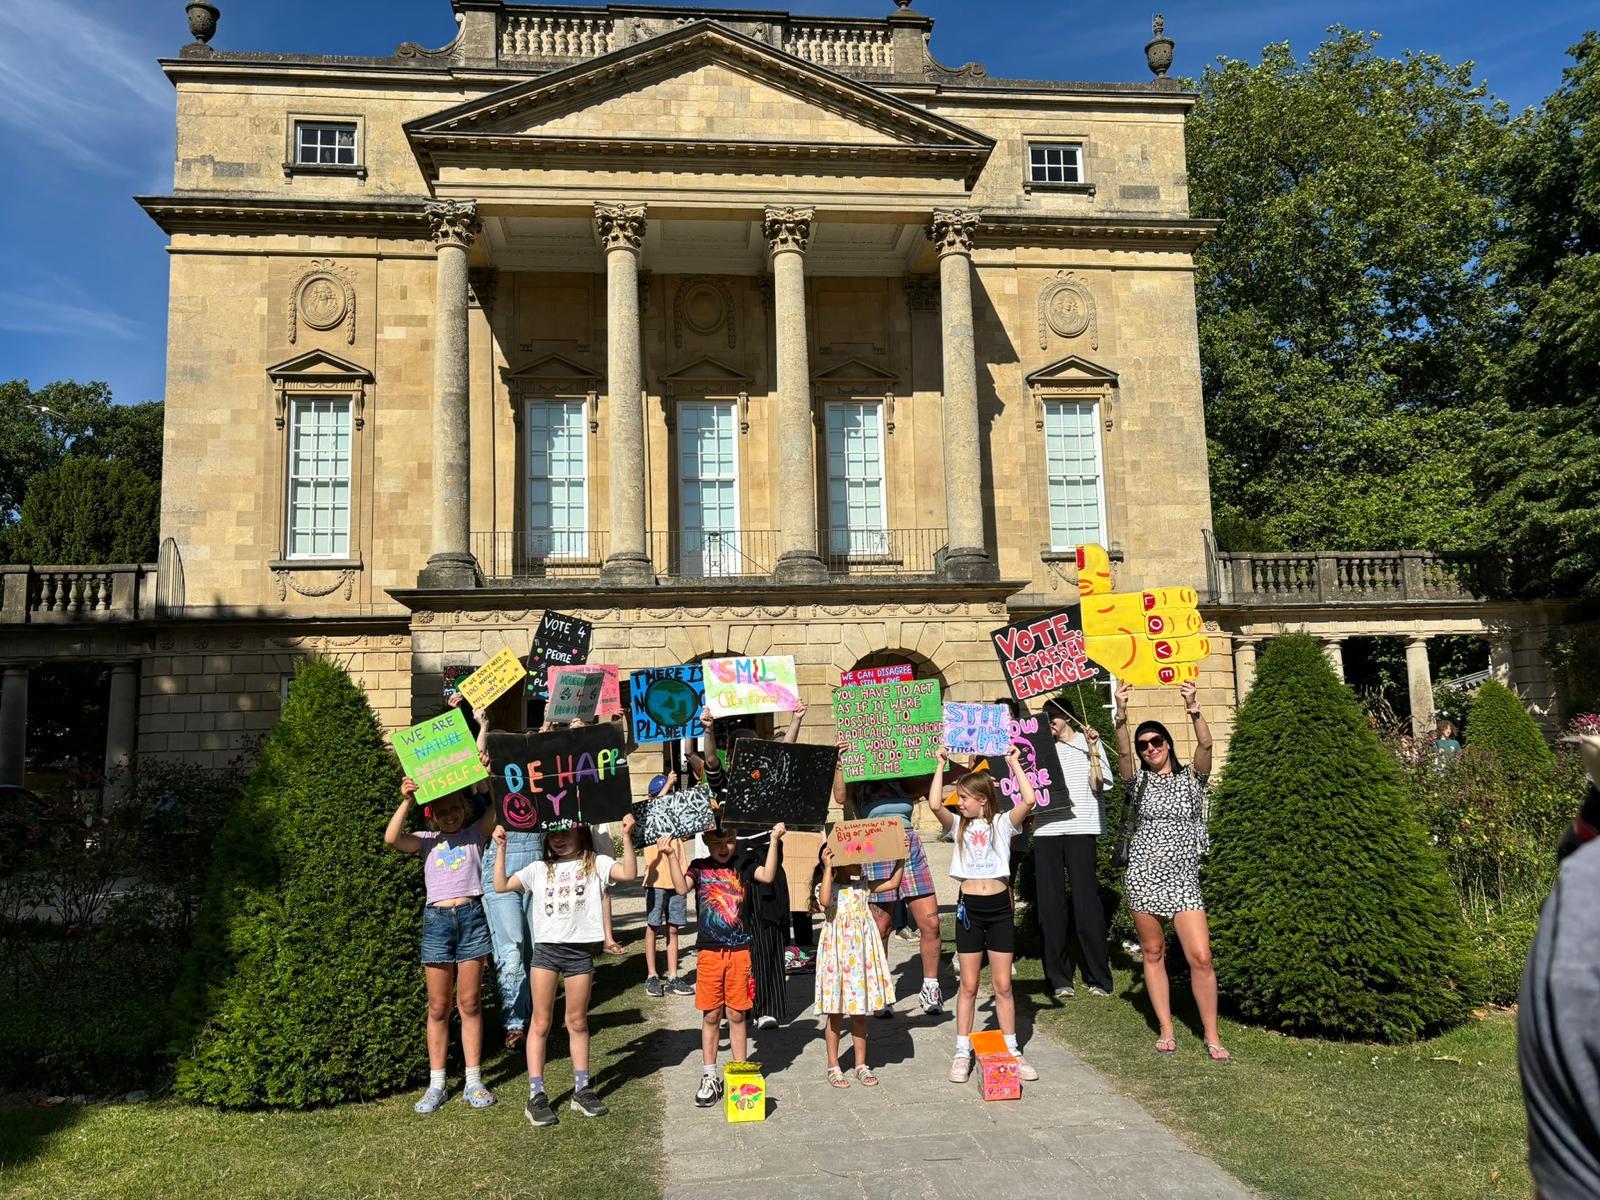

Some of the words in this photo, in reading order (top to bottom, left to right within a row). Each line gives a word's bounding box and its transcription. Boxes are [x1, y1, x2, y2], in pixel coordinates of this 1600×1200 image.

[545, 616, 572, 634] VOTE
[578, 626, 586, 638] 4
[994, 613, 1082, 660] VOTE.
[545, 648, 572, 664] PEOPLE
[1006, 637, 1084, 678] REPRESEN
[534, 678, 549, 687] PLA
[630, 667, 685, 689] THERE
[842, 672, 854, 680] WE
[857, 670, 874, 679] CAN
[877, 666, 912, 677] DISAGREE
[1012, 655, 1099, 699] ENGAGE.
[836, 690, 856, 700] YOU
[861, 687, 890, 698] HAVE
[896, 685, 910, 696] TO
[913, 683, 933, 694] ACT
[838, 703, 850, 714] AS
[855, 702, 868, 712] IF
[874, 700, 886, 712] IT
[890, 698, 920, 710] WERE
[838, 712, 888, 728] POSSIBLE
[895, 710, 910, 722] TO
[1010, 717, 1038, 738] OW
[401, 728, 426, 746] WE
[432, 716, 454, 733] ARE
[637, 719, 687, 740] PLANET
[838, 726, 892, 742] RADICALLY
[414, 730, 462, 760] NATURE
[864, 738, 898, 751] WORLD
[902, 736, 922, 748] AND
[840, 753, 866, 764] HAVE
[872, 751, 886, 760] TO
[890, 751, 903, 760] DO
[908, 749, 920, 760] IT
[924, 748, 936, 759] AL
[504, 760, 544, 793] BE
[845, 766, 865, 778] THE
[871, 761, 903, 774] TIME.
[421, 765, 470, 797] ITSELF
[546, 790, 568, 816] Y
[1010, 788, 1050, 807] YU
[837, 831, 852, 842] Big
